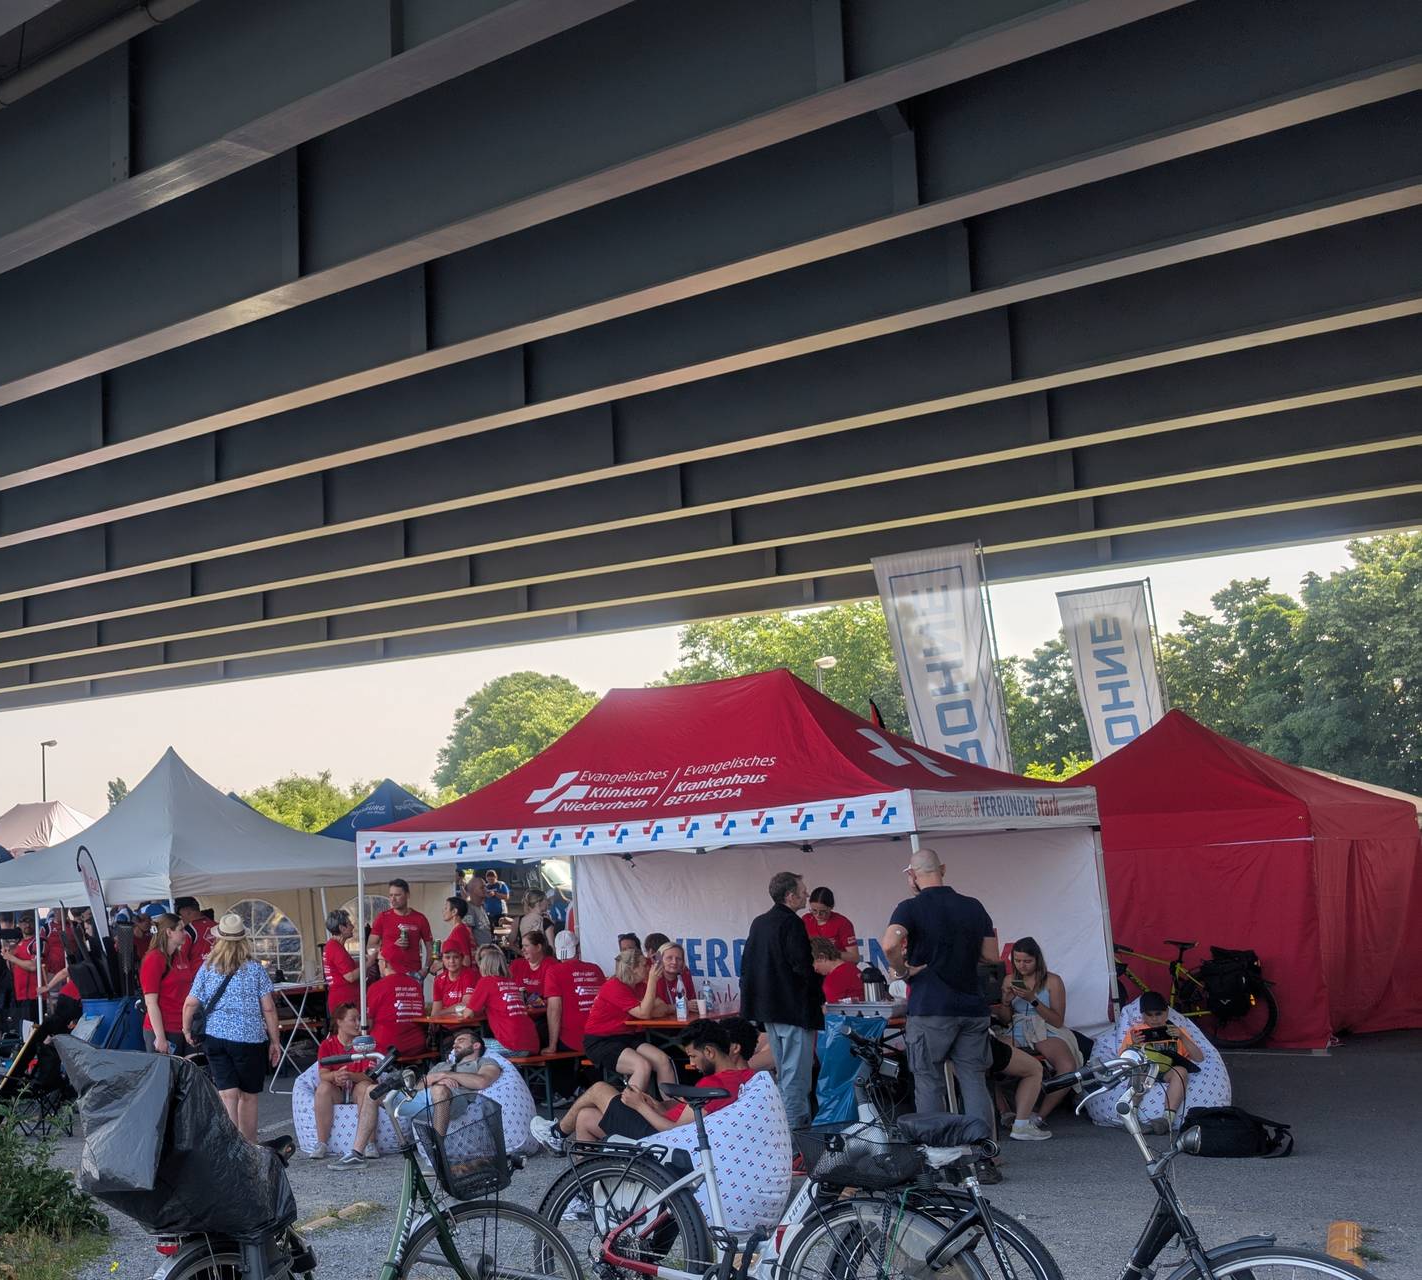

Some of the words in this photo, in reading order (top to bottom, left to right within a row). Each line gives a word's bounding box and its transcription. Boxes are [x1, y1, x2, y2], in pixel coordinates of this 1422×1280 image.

[684, 755, 776, 777] Evangelisches
[580, 769, 669, 785] Evangelisches
[674, 773, 767, 792] Krankenhaus
[589, 785, 658, 798] Klinikum
[663, 787, 742, 806] BETHESDA
[558, 799, 648, 812] Niederrhein
[394, 1198, 415, 1266] NTILOPE
